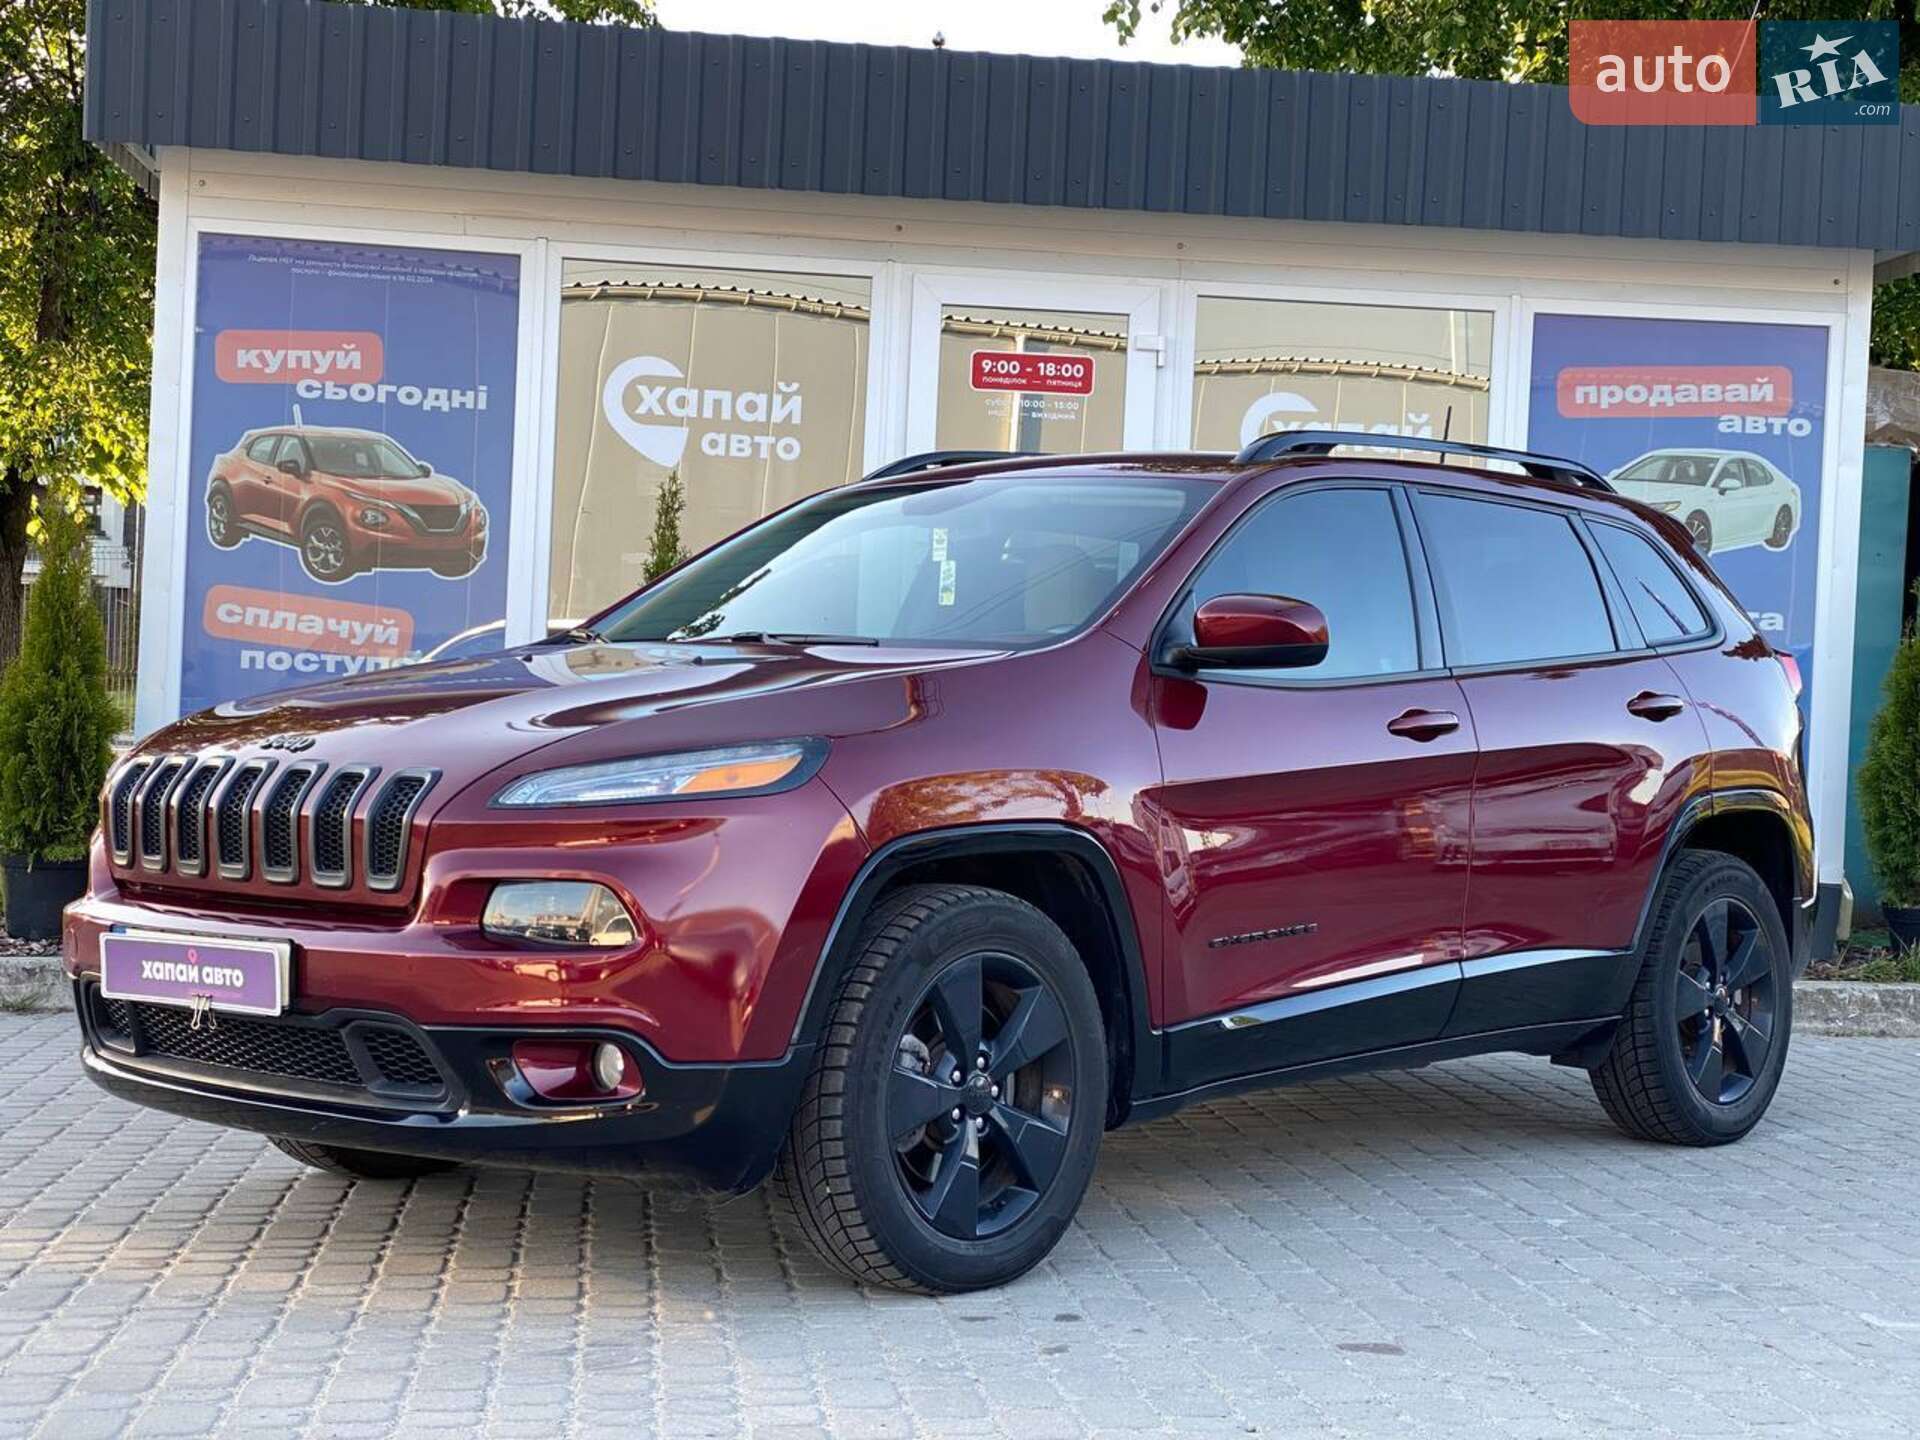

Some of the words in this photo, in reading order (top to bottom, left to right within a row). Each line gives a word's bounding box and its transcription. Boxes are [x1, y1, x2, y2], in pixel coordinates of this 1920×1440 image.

[236, 343, 361, 374] купуй
[981, 359, 1020, 374] 9:00
[1037, 362, 1084, 377] 18:00
[296, 378, 489, 412] сьогодні
[634, 381, 802, 424] хапай
[1575, 377, 1774, 408] продавай
[1717, 414, 1812, 437] авто
[701, 431, 802, 461] авто
[216, 602, 400, 645] сплачуй
[202, 965, 244, 987] авто
